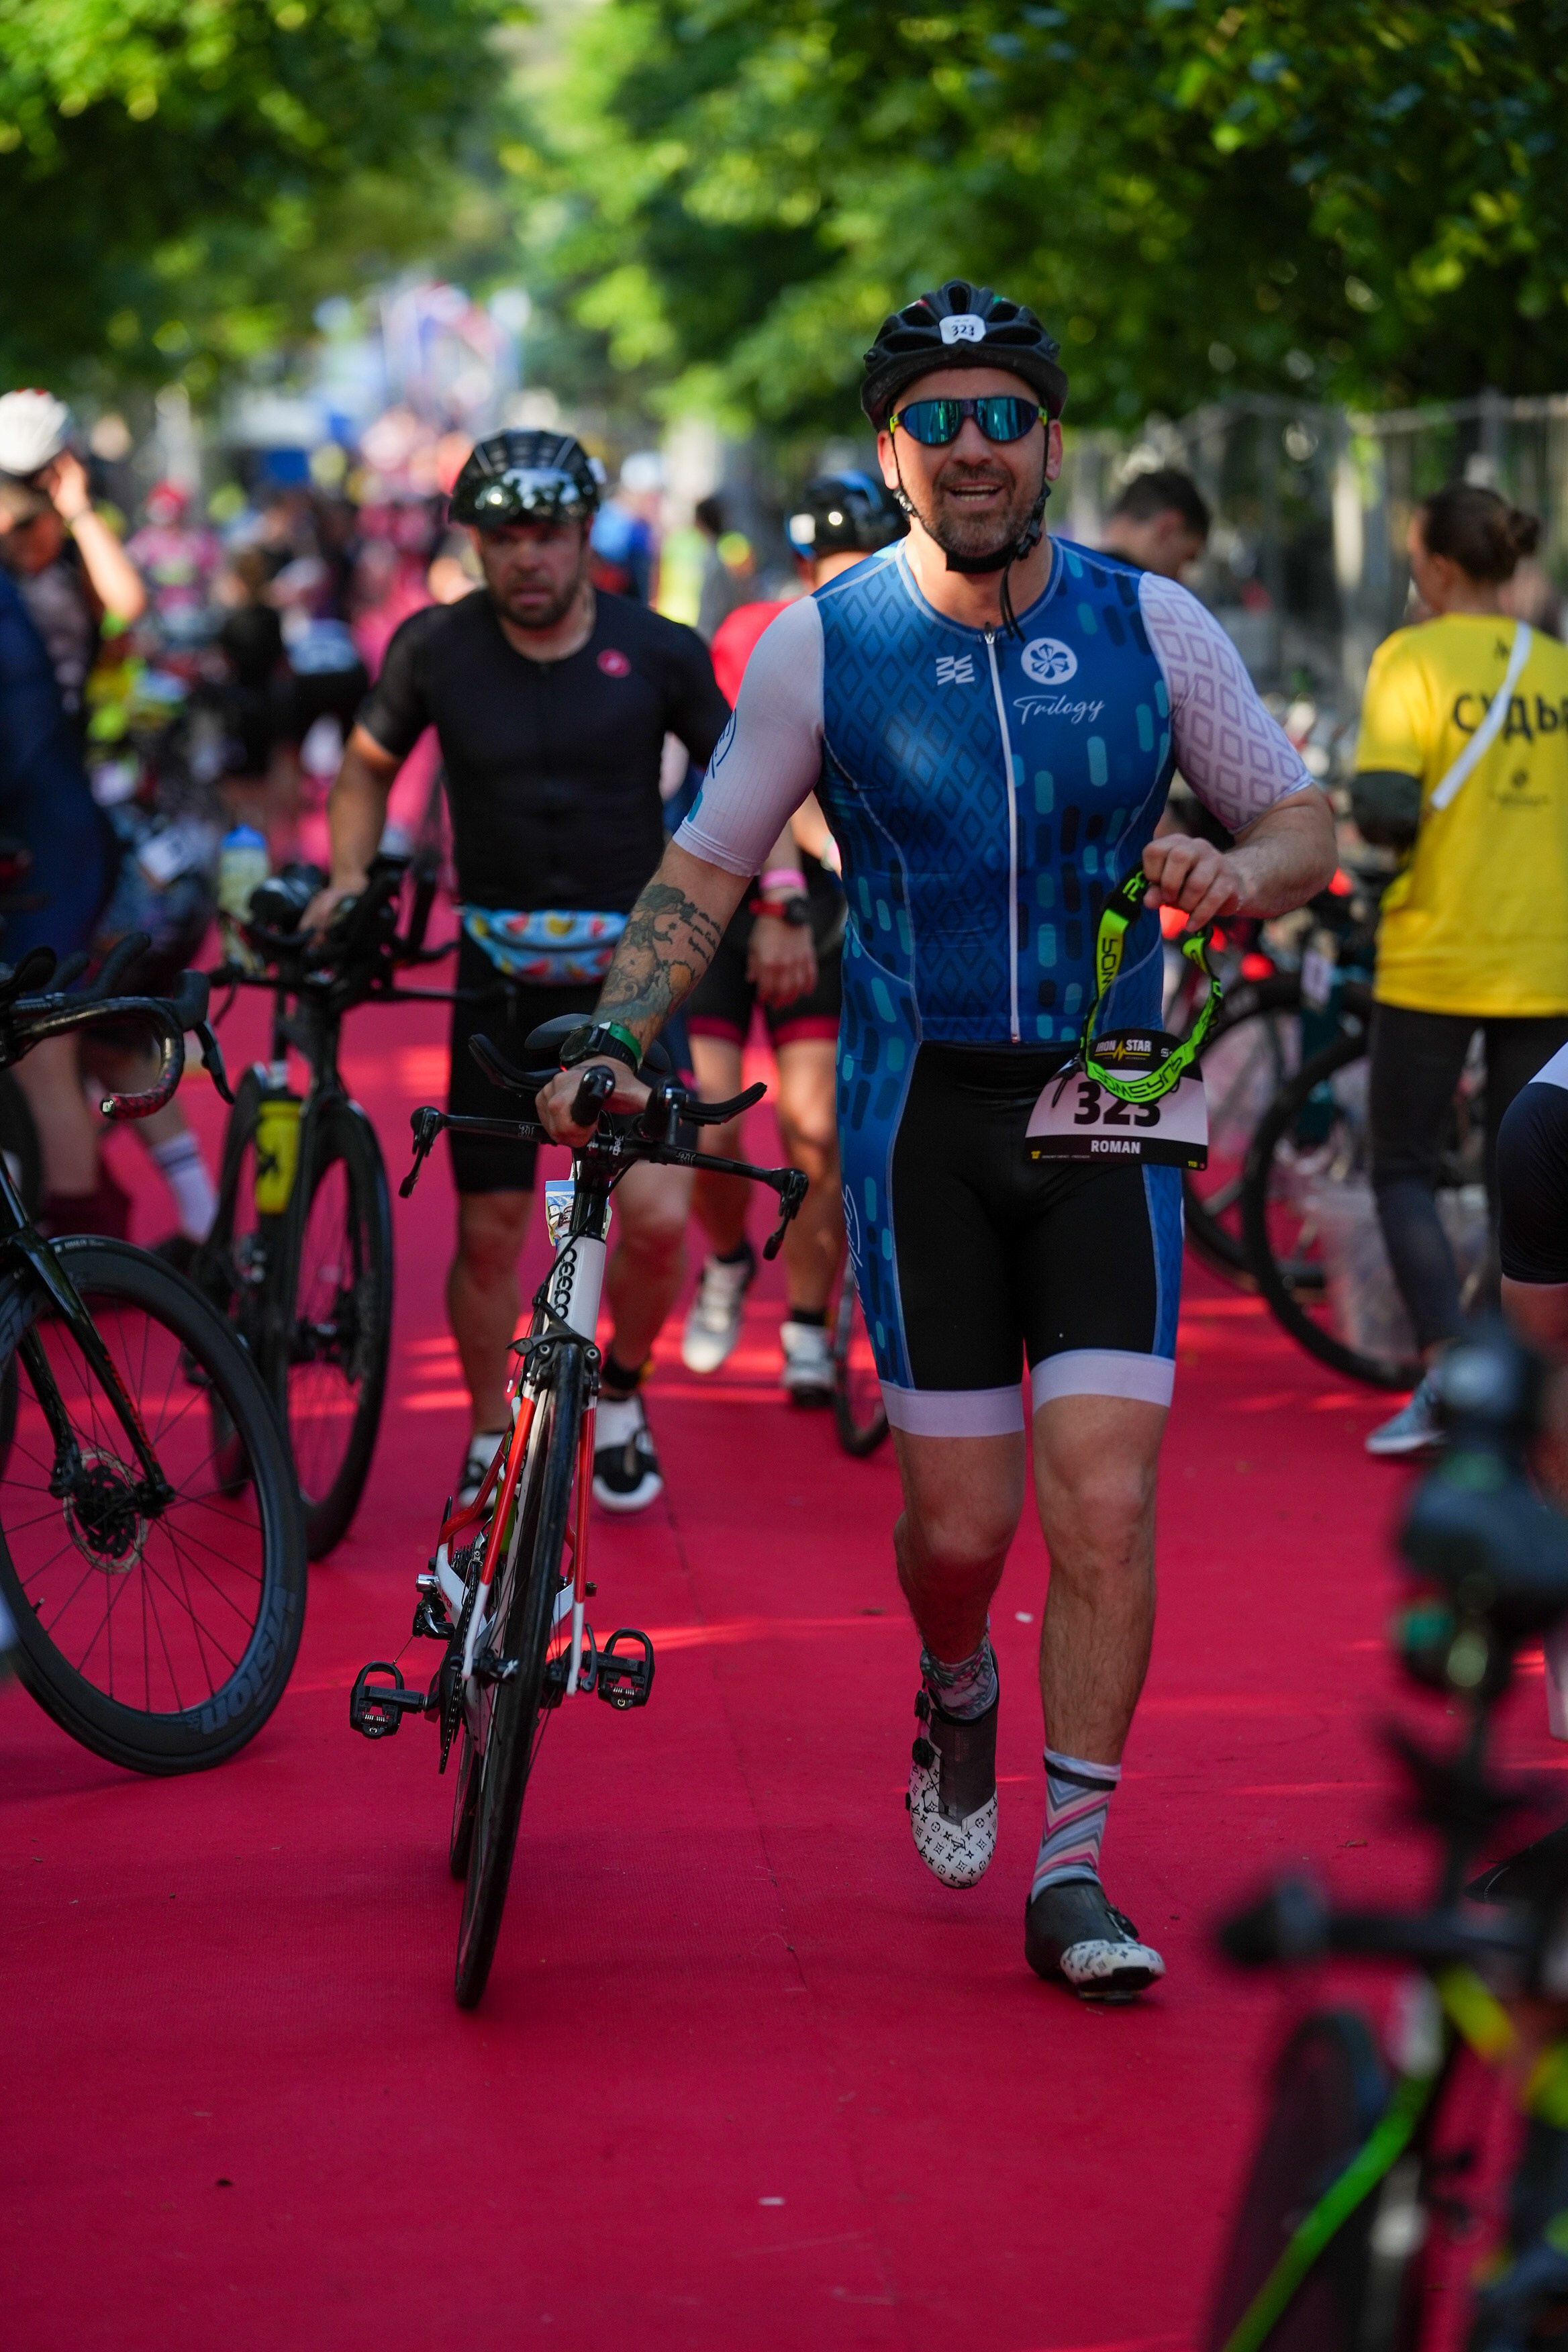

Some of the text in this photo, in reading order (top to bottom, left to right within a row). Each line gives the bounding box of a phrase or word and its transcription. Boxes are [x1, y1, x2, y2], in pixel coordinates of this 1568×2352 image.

[1013, 695, 1105, 725] Trilogy
[1453, 692, 1568, 744] СДЬ
[1095, 1040, 1117, 1052] IRON
[1126, 1039, 1153, 1052] STAR
[1073, 1081, 1161, 1127] 323
[1091, 1140, 1141, 1155] ROMAN
